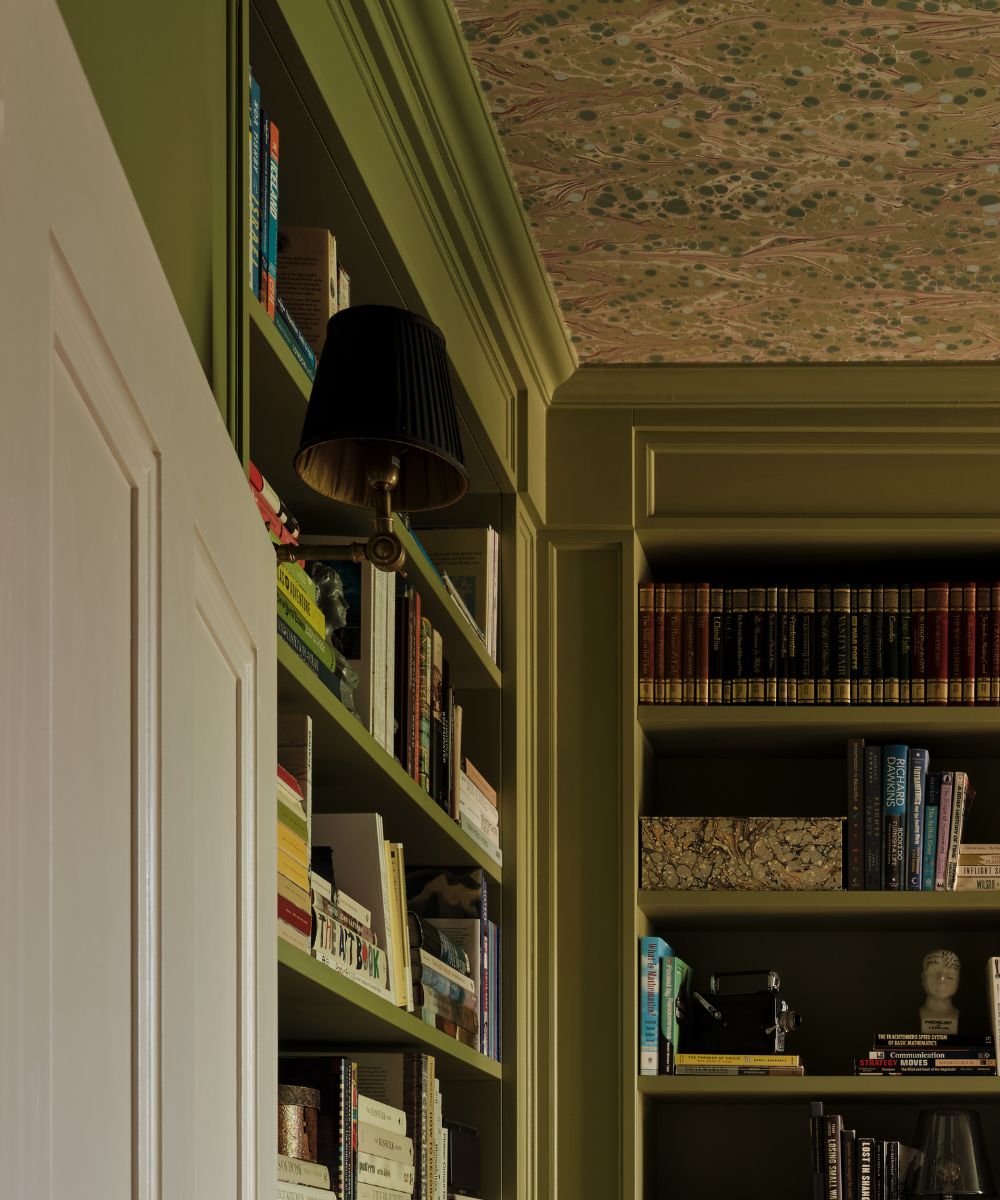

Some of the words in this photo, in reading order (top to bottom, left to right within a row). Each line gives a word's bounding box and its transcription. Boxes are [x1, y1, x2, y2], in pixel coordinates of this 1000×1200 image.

[838, 616, 846, 651] VANITY
[886, 756, 895, 807] DAWKINS
[896, 758, 905, 806] RICHARD
[953, 835, 958, 843] OF
[897, 851, 903, 861] DO
[964, 867, 992, 875] INFLIGHT
[648, 943, 657, 960] What
[665, 988, 672, 997] by
[828, 1139, 836, 1164] LOSING
[862, 1142, 870, 1162] LOST
[828, 1166, 837, 1189] SMALL
[862, 1165, 870, 1174] IN
